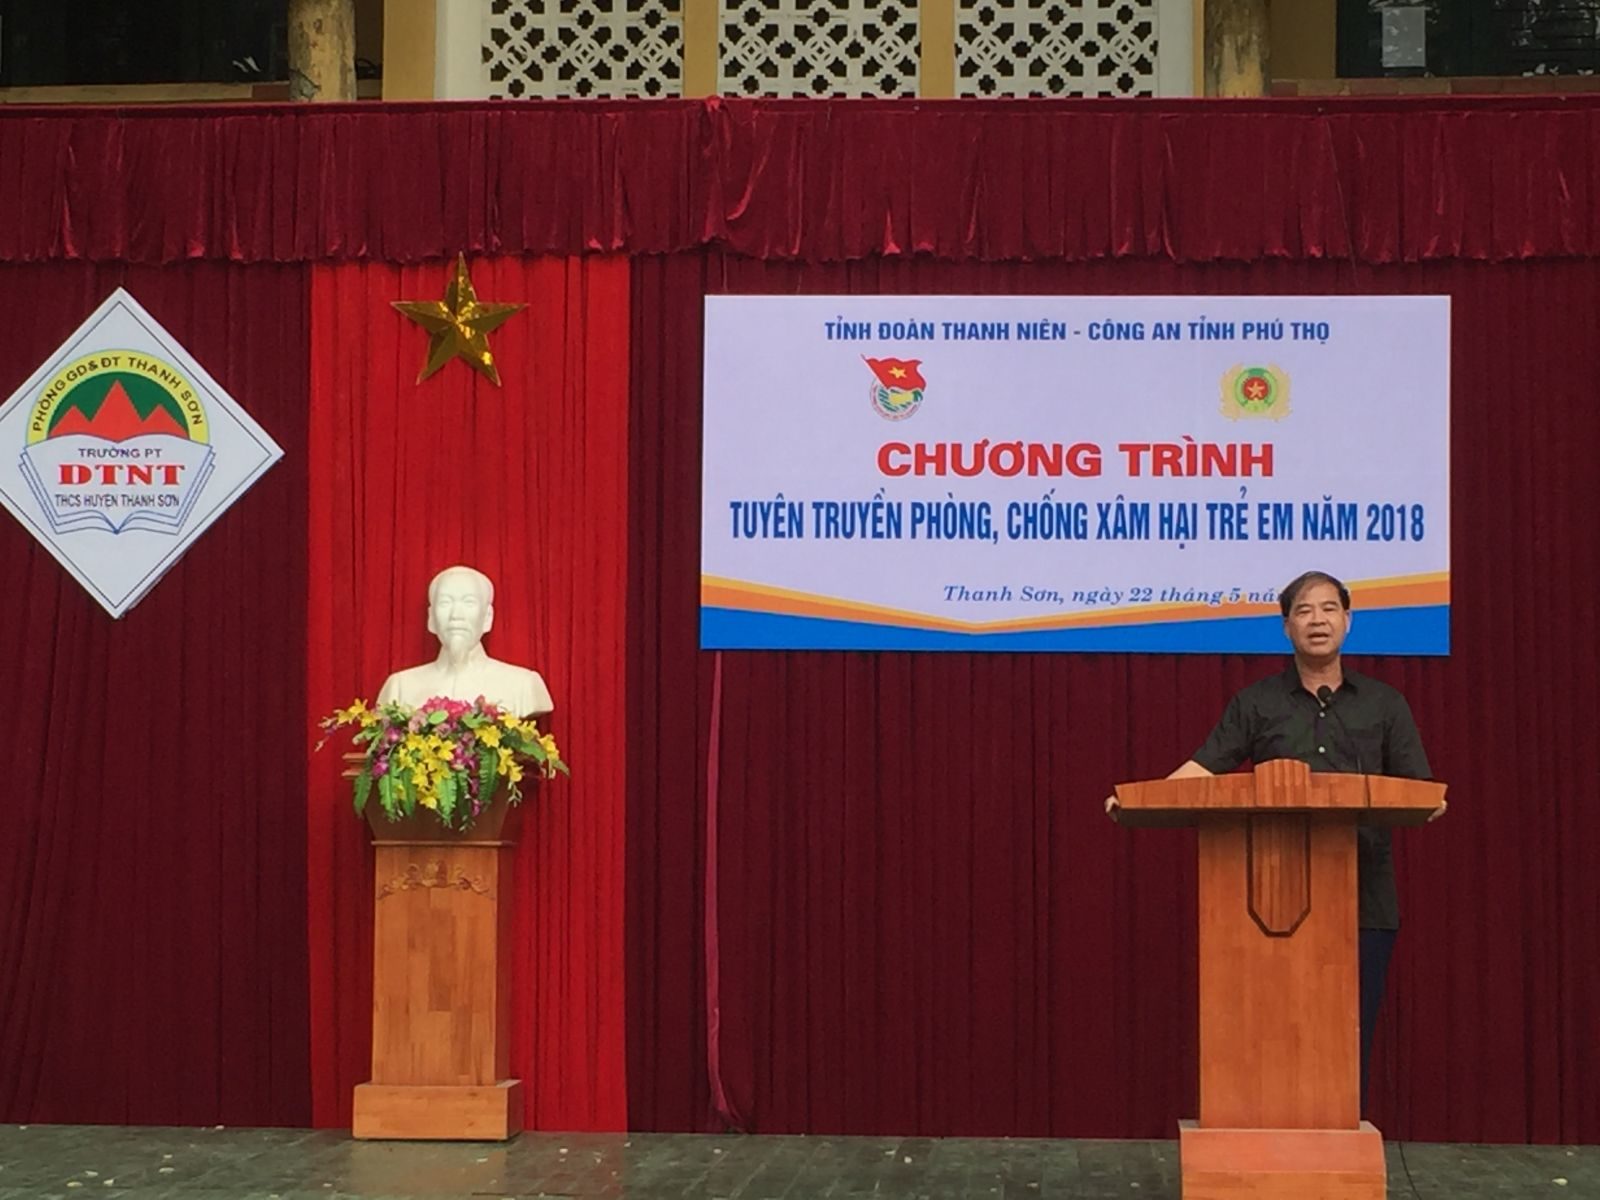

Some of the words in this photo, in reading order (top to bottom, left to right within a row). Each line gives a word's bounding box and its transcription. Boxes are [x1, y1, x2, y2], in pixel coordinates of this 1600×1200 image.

[825, 316, 871, 340] TỈNH
[878, 318, 935, 341] ĐOÀN
[942, 322, 1010, 340] THANH
[1016, 318, 1066, 340] NIÊN
[1088, 318, 1145, 340] CÔNG
[1152, 322, 1181, 340] AN
[1188, 315, 1235, 340] TỈNH
[1242, 318, 1284, 340] PHÚ
[1290, 322, 1330, 345] THỌ
[32, 379, 66, 432] PHÒNG
[128, 356, 181, 389] THANH
[181, 390, 203, 425] SƠN
[79, 446, 140, 458] TRƯỜNG
[144, 448, 162, 458] PT
[878, 438, 1102, 477] CHƯƠNG
[1118, 435, 1275, 477] TRÌNH
[58, 464, 186, 485] DTNT
[55, 494, 81, 507] THCS
[121, 494, 155, 507] THANH
[160, 494, 180, 507] SƠN
[730, 492, 804, 539] TUYÊN
[812, 487, 902, 539] TRUYỀN
[911, 492, 999, 544] PHÒNG,
[1007, 488, 1088, 540] CHỐNG
[1096, 495, 1150, 540] XÂM
[1159, 502, 1198, 550] HẠI
[1205, 485, 1249, 540] TRẺ
[1257, 502, 1294, 540] EM
[1302, 495, 1358, 541] NĂM
[1366, 503, 1425, 541] 2018
[943, 585, 1012, 602] Thanh
[1020, 586, 1064, 604] Sơn,
[1072, 587, 1123, 605] ngày
[1128, 587, 1152, 602] 22
[1160, 587, 1223, 604] tháng
[1229, 587, 1241, 602] 5
